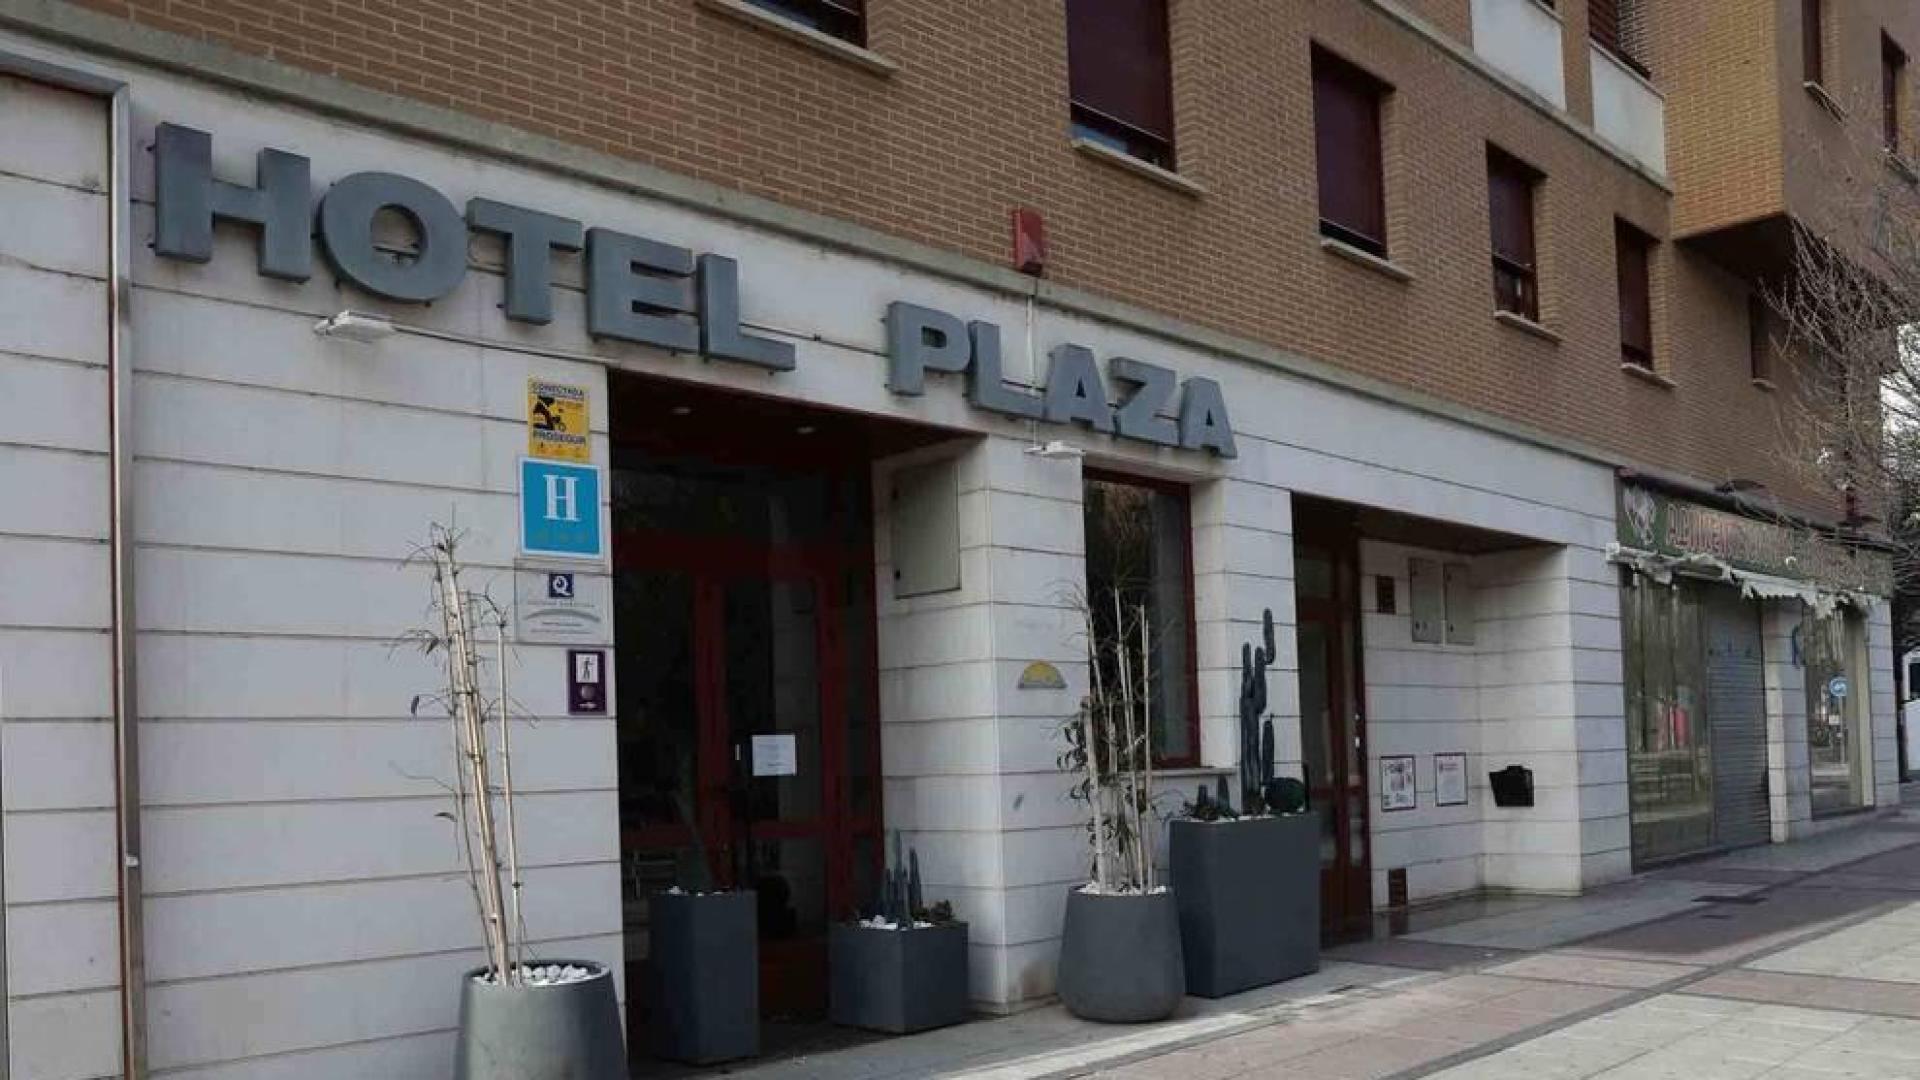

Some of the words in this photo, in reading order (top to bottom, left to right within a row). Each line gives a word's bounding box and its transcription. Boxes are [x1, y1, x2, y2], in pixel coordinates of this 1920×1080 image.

[154, 122, 796, 371] HOTEL
[887, 300, 1238, 459] PLAZA
[542, 474, 582, 522] H
